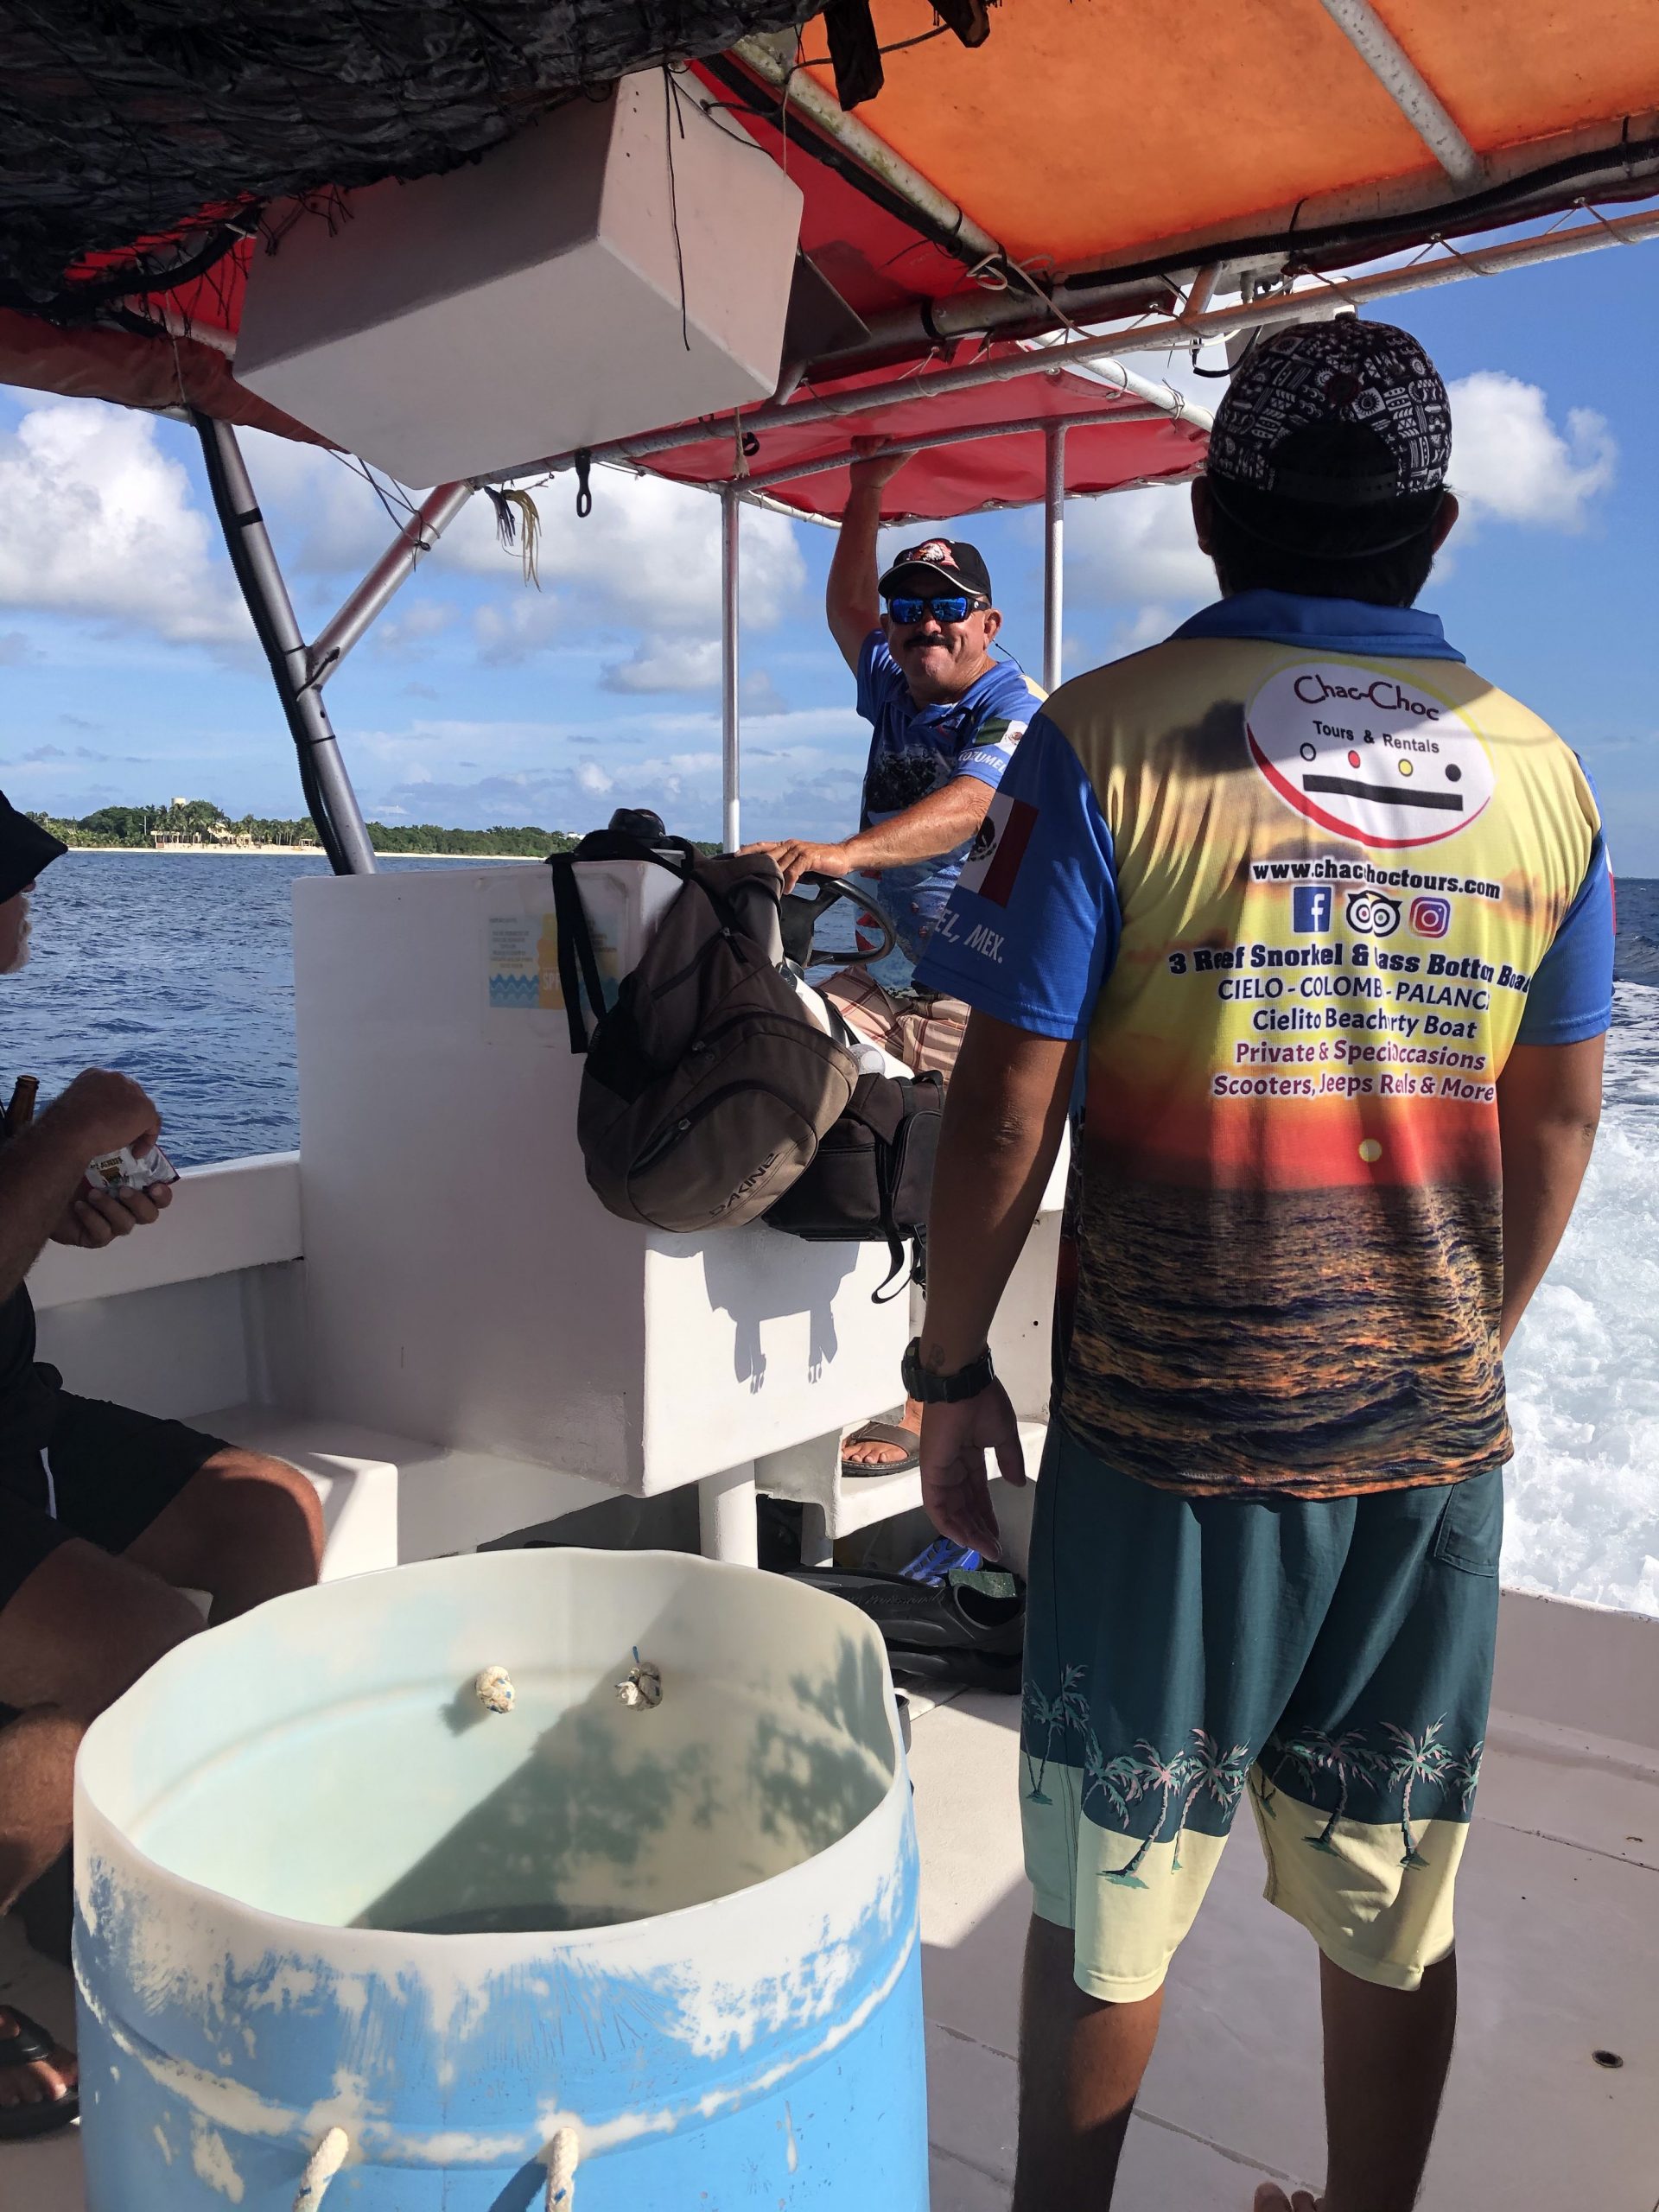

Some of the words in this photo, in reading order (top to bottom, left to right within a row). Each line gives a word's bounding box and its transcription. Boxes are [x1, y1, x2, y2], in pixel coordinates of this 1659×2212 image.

[1313, 720, 1354, 741] Tours
[1363, 729, 1375, 744] &
[1382, 733, 1440, 753] Rentals
[1253, 859, 1501, 899] www.chachoctours.com
[963, 924, 1004, 963] MEX.
[1169, 953, 1187, 974] 3
[1250, 944, 1343, 968] Snorkel
[1352, 944, 1369, 966] &
[1218, 977, 1283, 1001] CIELO
[1300, 976, 1383, 998] COLOMB
[1395, 982, 1490, 1010] PALANC
[1253, 1008, 1321, 1030] Cielito
[1325, 1007, 1387, 1030] Beach
[1424, 1015, 1478, 1039] Boat
[1236, 1041, 1315, 1063] Private
[1319, 1042, 1329, 1060] &
[1334, 1039, 1392, 1065] Speci
[1213, 1075, 1316, 1096] Scooters,
[1319, 1073, 1373, 1096] Jeeps
[1420, 1077, 1436, 1095] &
[1441, 1077, 1495, 1102] More
